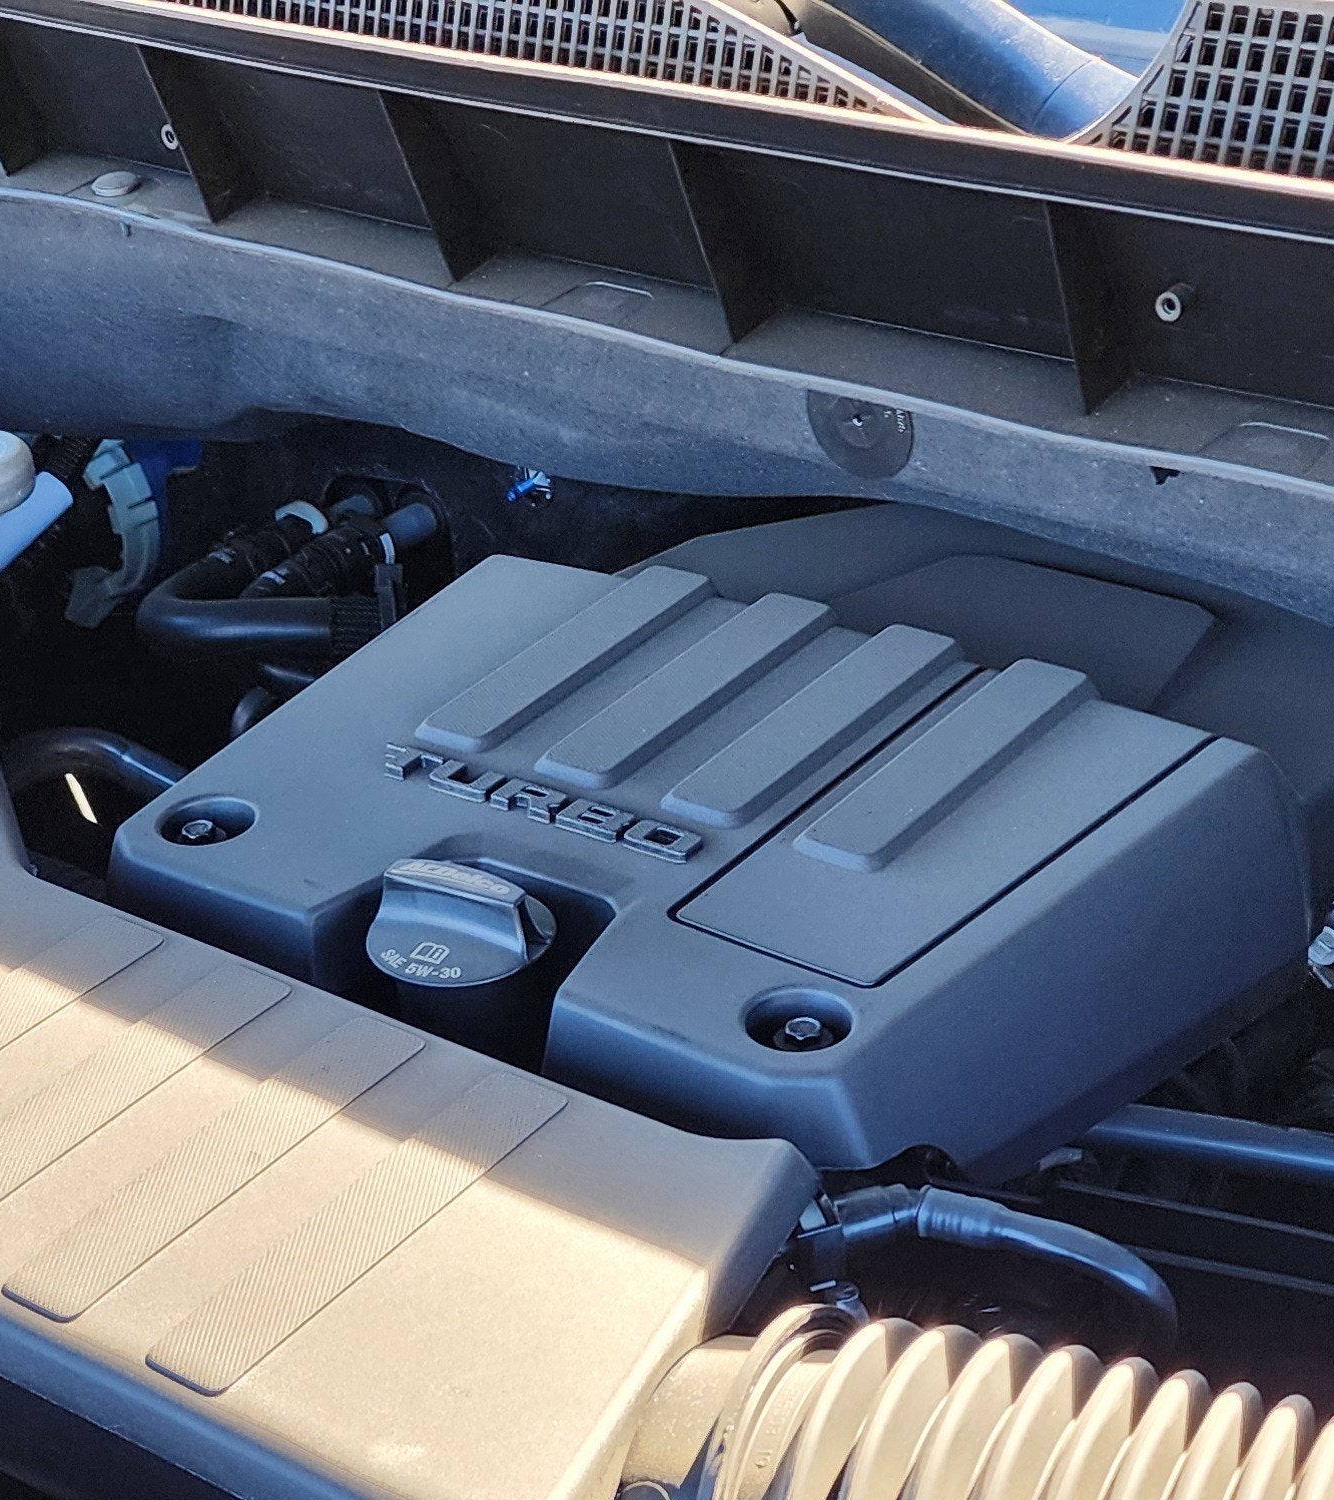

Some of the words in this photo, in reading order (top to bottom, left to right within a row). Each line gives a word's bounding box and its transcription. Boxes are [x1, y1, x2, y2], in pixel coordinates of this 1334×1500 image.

[384, 741, 703, 864] TURBO
[395, 859, 511, 895] ACDelco
[380, 947, 408, 969] SAE
[404, 961, 462, 980] 5W-30
